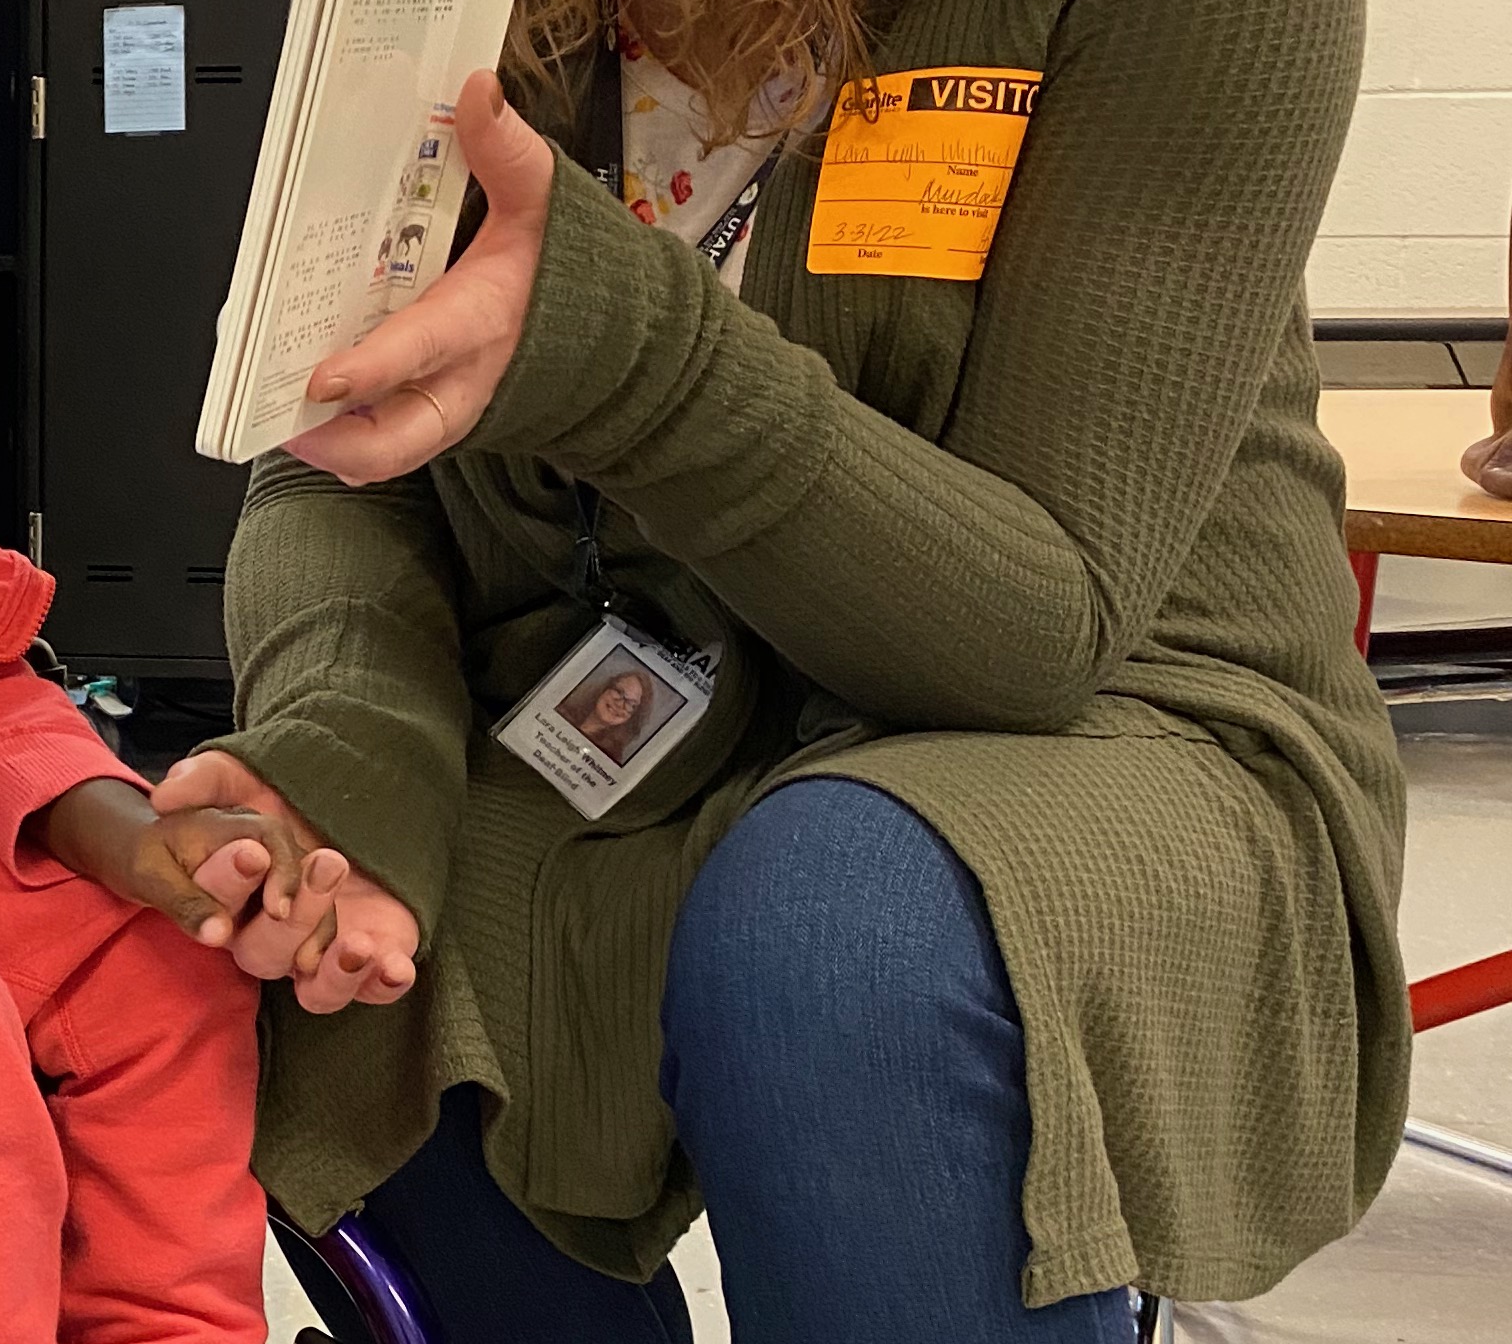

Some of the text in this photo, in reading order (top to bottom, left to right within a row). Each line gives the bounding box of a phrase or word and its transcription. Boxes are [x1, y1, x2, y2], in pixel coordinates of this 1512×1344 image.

[946, 165, 979, 177] Name
[933, 204, 956, 216] here
[959, 207, 969, 216] to
[857, 248, 883, 259] Date
[556, 730, 581, 755] Leigh
[535, 731, 597, 788] Teacher of the
